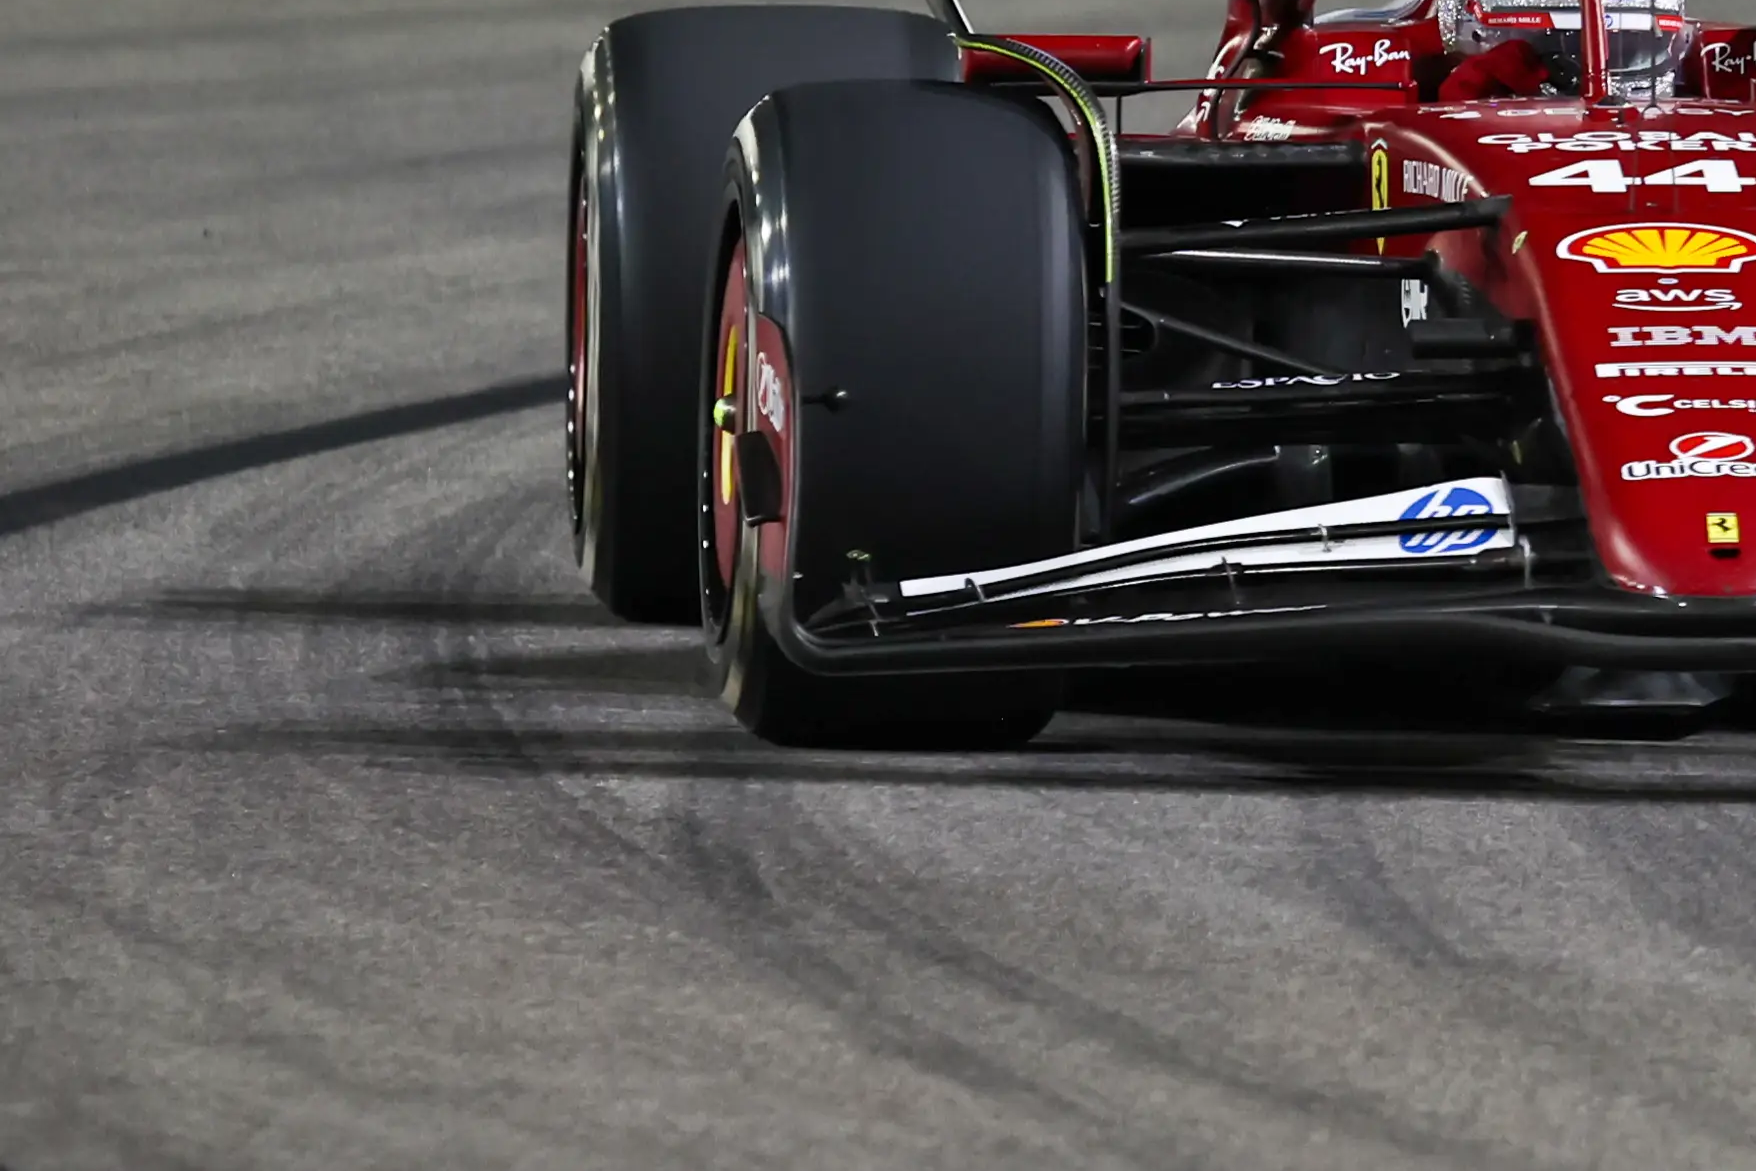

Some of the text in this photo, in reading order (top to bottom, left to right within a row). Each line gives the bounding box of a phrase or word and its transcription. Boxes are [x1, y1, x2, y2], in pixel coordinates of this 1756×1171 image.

[1319, 39, 1411, 75] Ray-Ban
[1529, 159, 1756, 193] 44
[1614, 288, 1738, 304] aws
